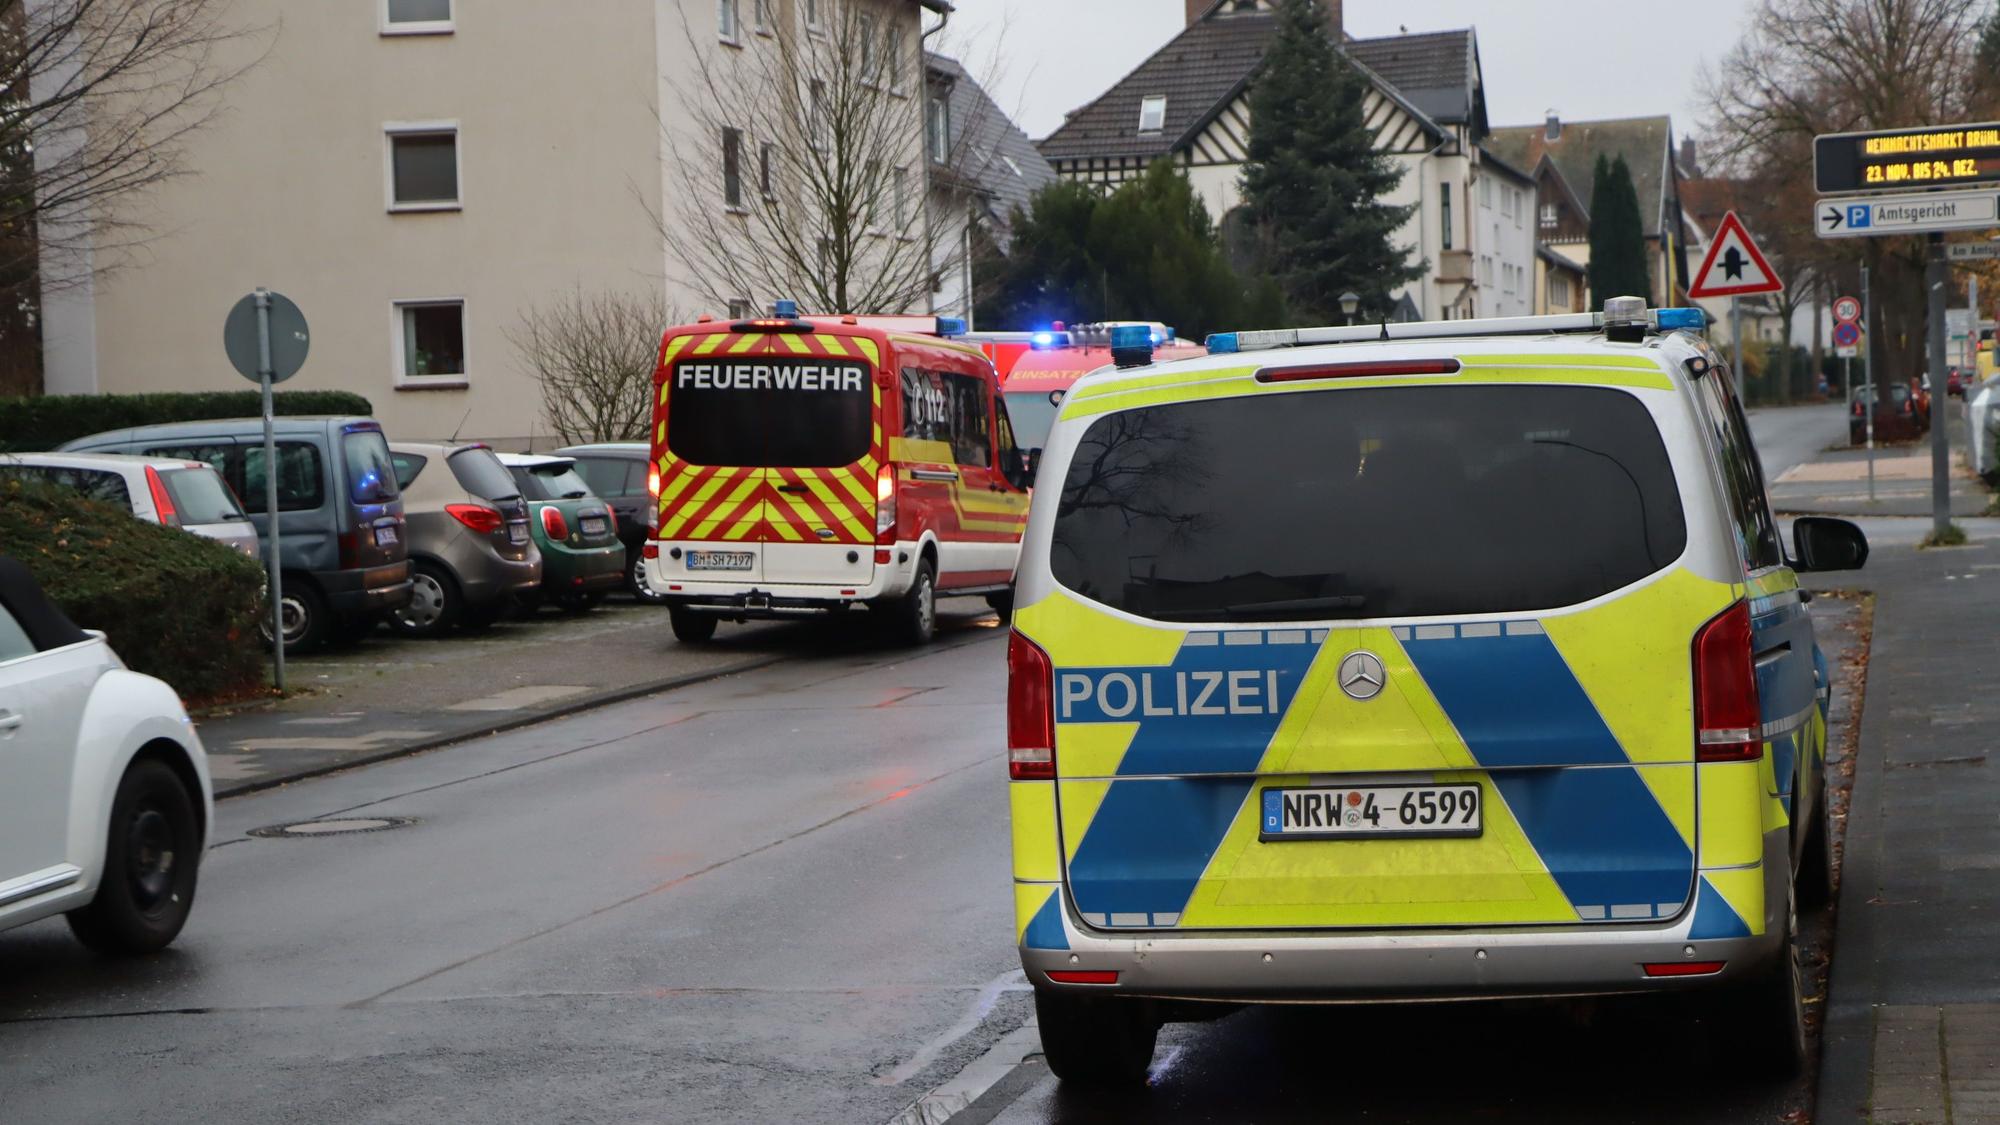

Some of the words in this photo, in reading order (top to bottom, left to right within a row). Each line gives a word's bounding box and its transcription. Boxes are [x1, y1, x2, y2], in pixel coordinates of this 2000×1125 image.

[1886, 163, 1911, 181] NOV.
[1913, 161, 1931, 179] BIS
[1933, 161, 1951, 179] 24.
[1953, 159, 1978, 177] DEZ.
[1852, 208, 1865, 226] P
[1878, 202, 1956, 223] Amtsgericht
[1839, 303, 1854, 316] 30
[678, 364, 863, 391] FEUERWEHR
[924, 388, 945, 422] 112
[1061, 669, 1279, 719] POLIZEI
[1283, 793, 1343, 828] NRW
[1362, 789, 1477, 826] 4-6599
